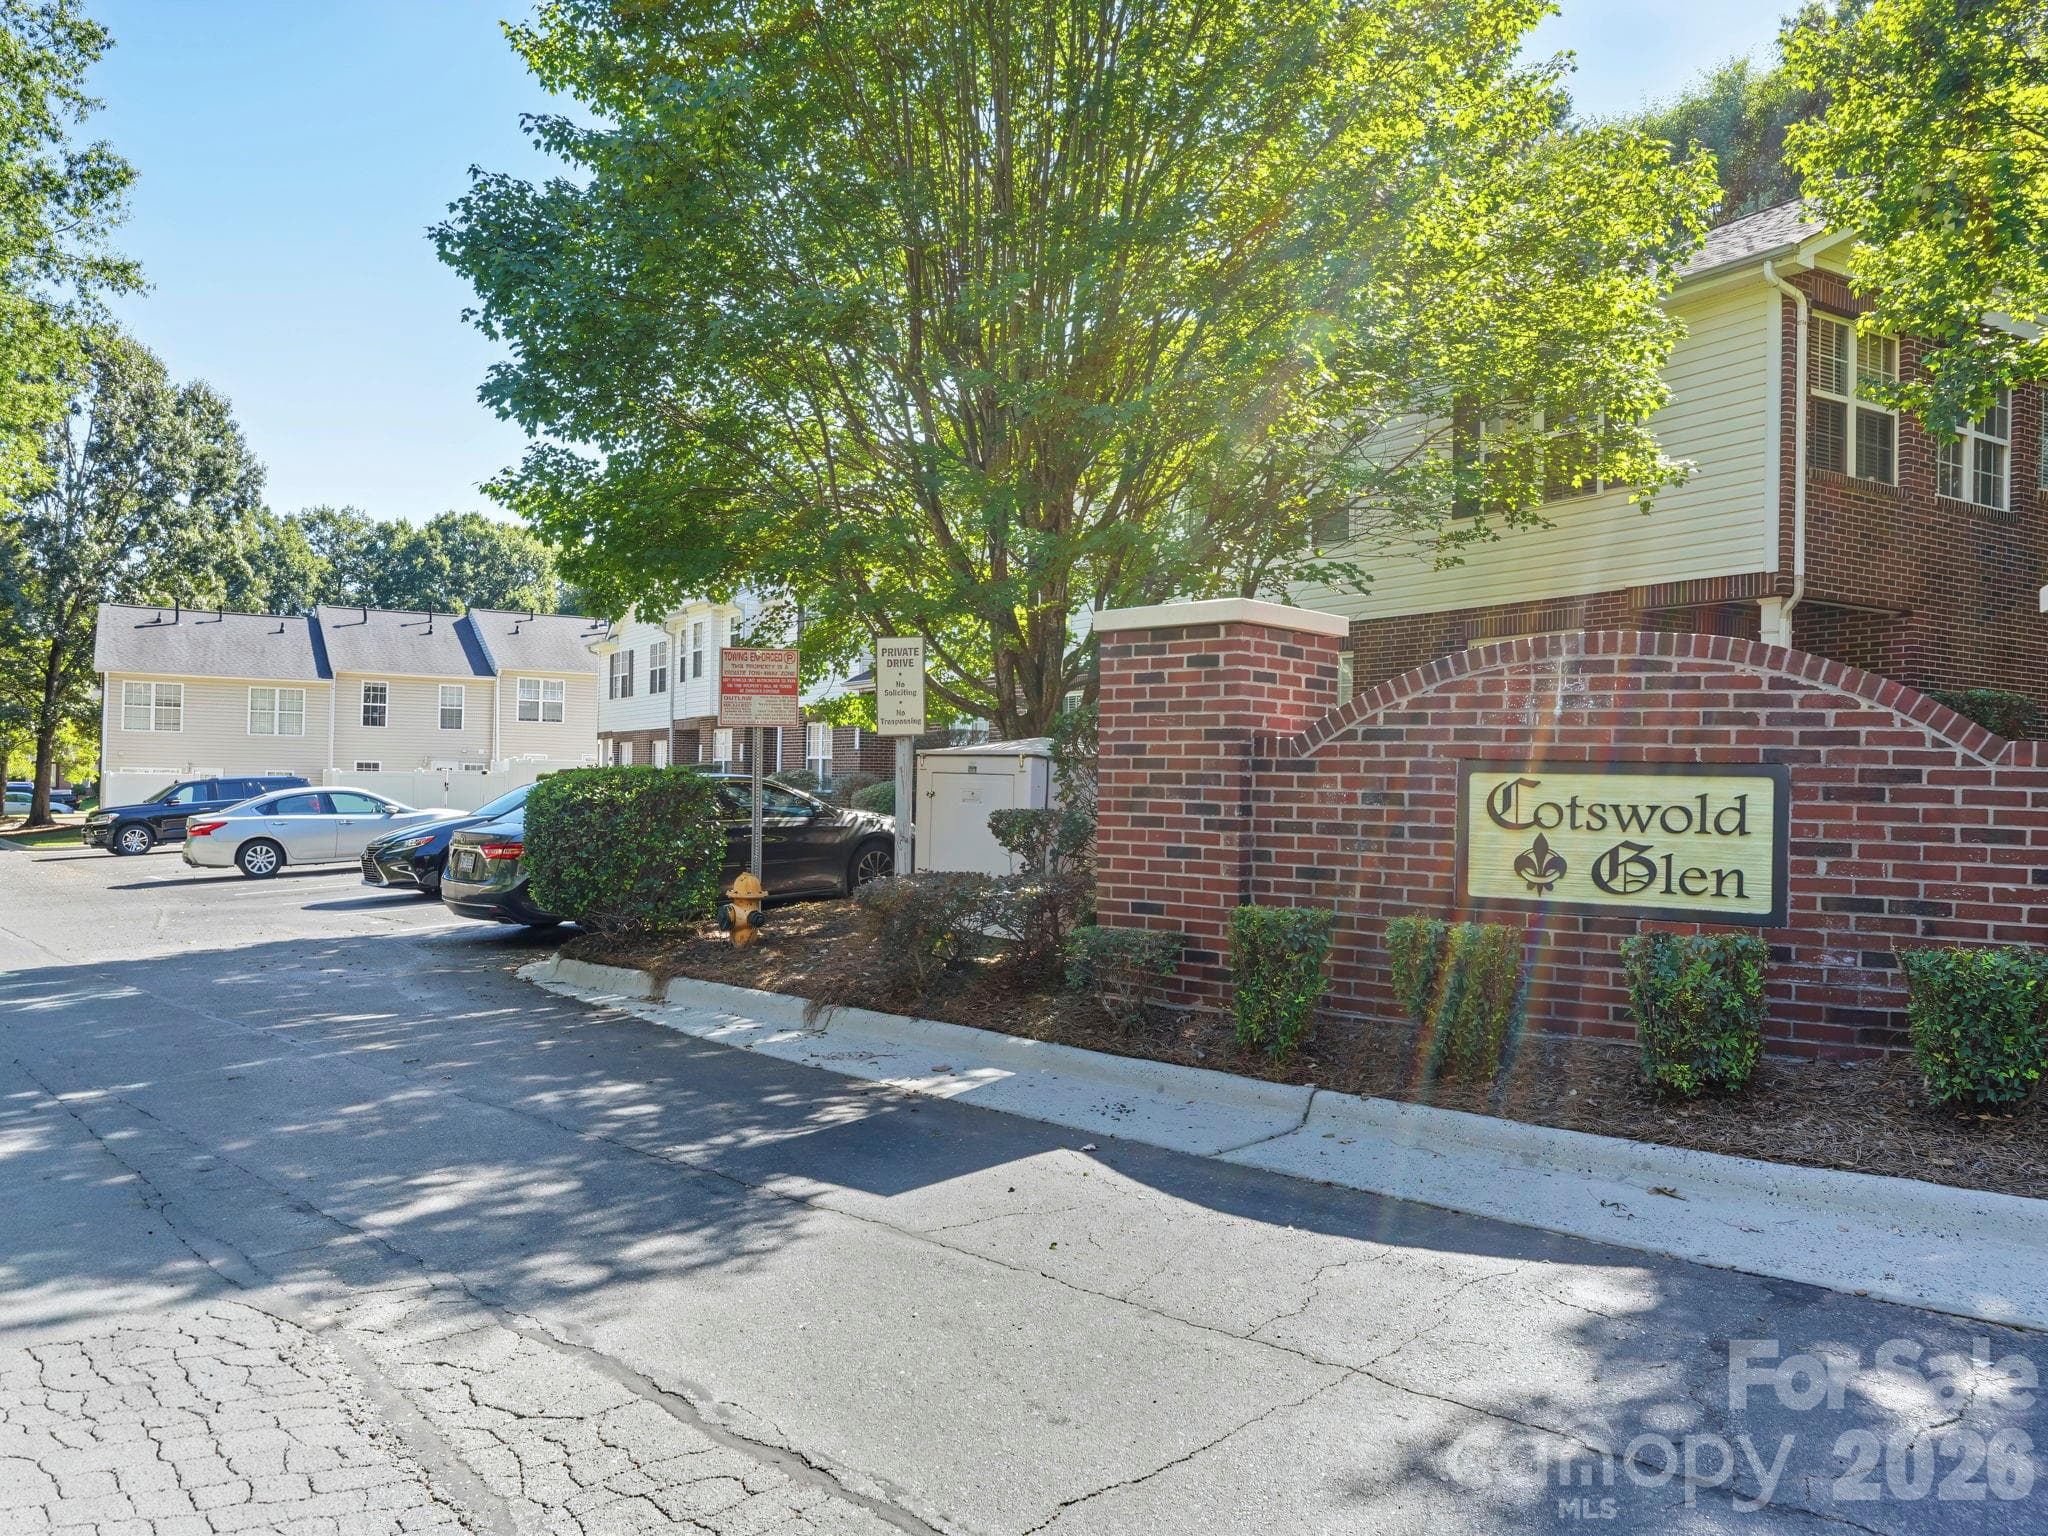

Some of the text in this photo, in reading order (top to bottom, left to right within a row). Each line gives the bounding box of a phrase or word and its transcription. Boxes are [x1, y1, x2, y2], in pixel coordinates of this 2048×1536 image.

[724, 651, 748, 662] TOWING
[881, 648, 920, 657] PRIVATE
[887, 659, 914, 668] DRIVE
[884, 689, 917, 697] Soliciting
[897, 709, 906, 717] No
[881, 718, 921, 726] Trespassing
[1486, 777, 1752, 837] Cotswold
[1591, 840, 1750, 899] Glen
